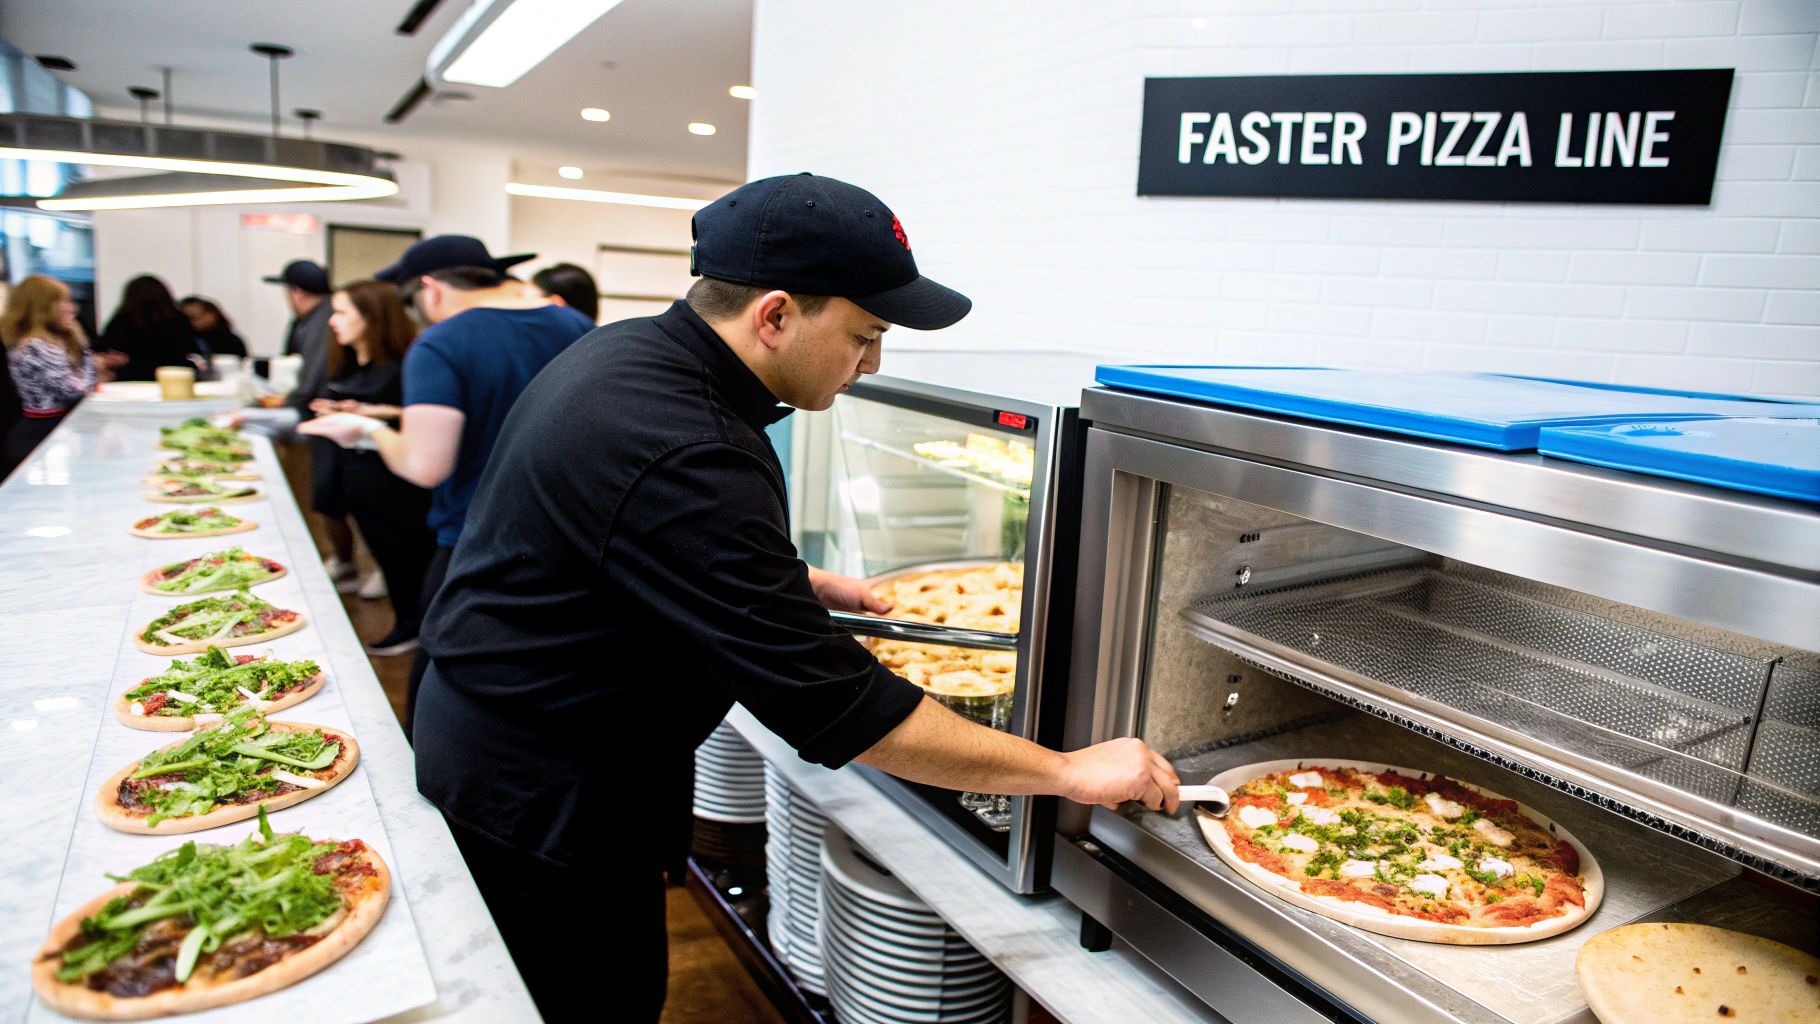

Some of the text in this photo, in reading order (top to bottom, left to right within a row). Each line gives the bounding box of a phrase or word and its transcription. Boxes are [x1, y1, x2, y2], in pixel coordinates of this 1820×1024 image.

[1178, 111, 1676, 168] FASTER PIZZA LINE
